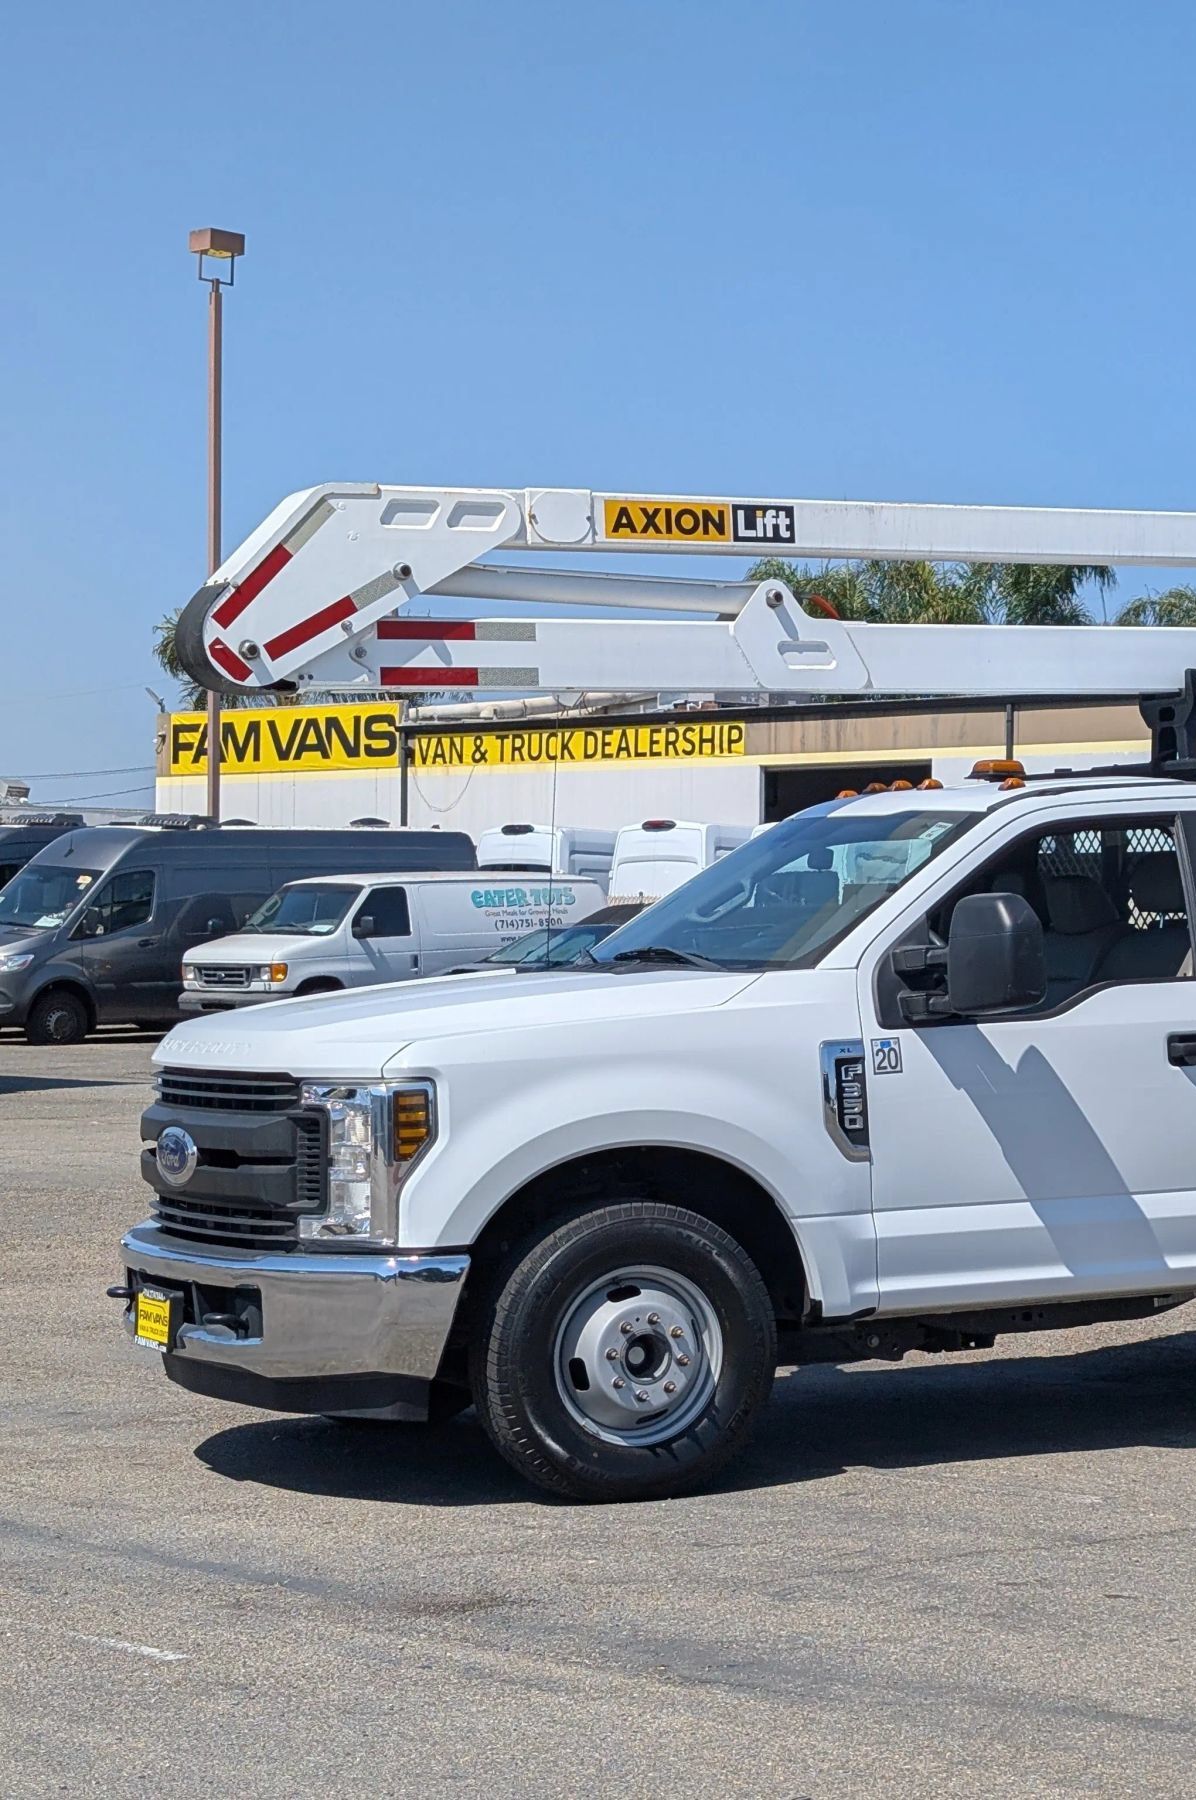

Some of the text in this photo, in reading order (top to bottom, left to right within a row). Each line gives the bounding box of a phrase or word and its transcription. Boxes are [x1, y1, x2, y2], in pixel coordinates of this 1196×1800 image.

[611, 506, 791, 538] AXION Lift
[417, 724, 743, 765] VAN & TRUCK DEALERSHIP
[471, 887, 576, 908] CATER TOTS
[875, 1047, 899, 1070] 20
[160, 1147, 181, 1167] Ford
